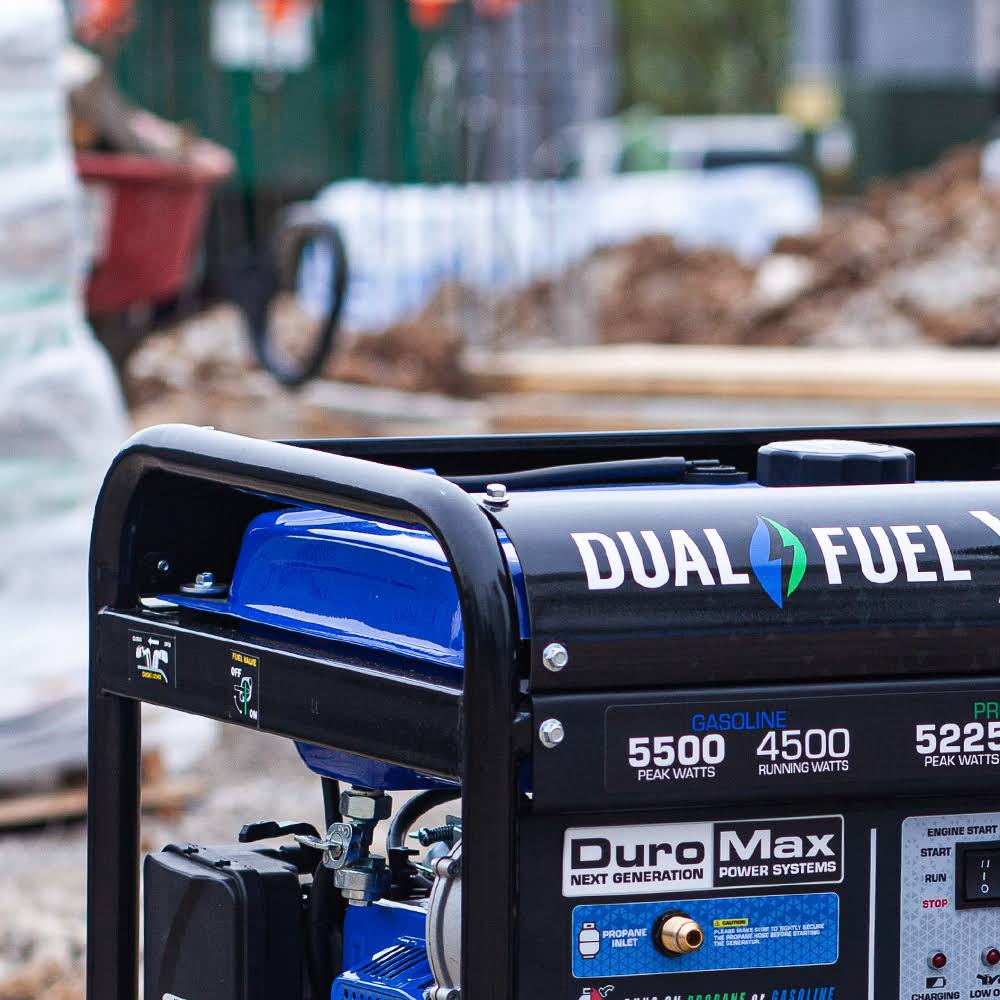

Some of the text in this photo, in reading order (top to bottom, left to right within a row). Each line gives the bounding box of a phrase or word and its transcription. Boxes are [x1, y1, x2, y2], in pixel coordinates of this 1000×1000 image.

[570, 528, 750, 591] DUAL
[811, 524, 972, 585] FUEL
[231, 666, 242, 677] OFF
[249, 709, 258, 720] ON
[692, 711, 787, 732] GASOLINE
[628, 728, 850, 768] 5500 4500
[924, 753, 1000, 767] PEAK WATTS
[638, 766, 715, 781] PEAK WATTS
[759, 760, 849, 775] RUNNING WATTS
[927, 825, 998, 837] ENGINE START
[920, 847, 951, 857] START
[720, 861, 836, 878] POWER SYSTEMS
[571, 868, 703, 886] NEXT GENERATION
[925, 874, 946, 882] RUN
[922, 899, 948, 908] STOP
[603, 928, 647, 939] PROPANE
[611, 938, 638, 948] INLET
[970, 989, 991, 998] LOW
